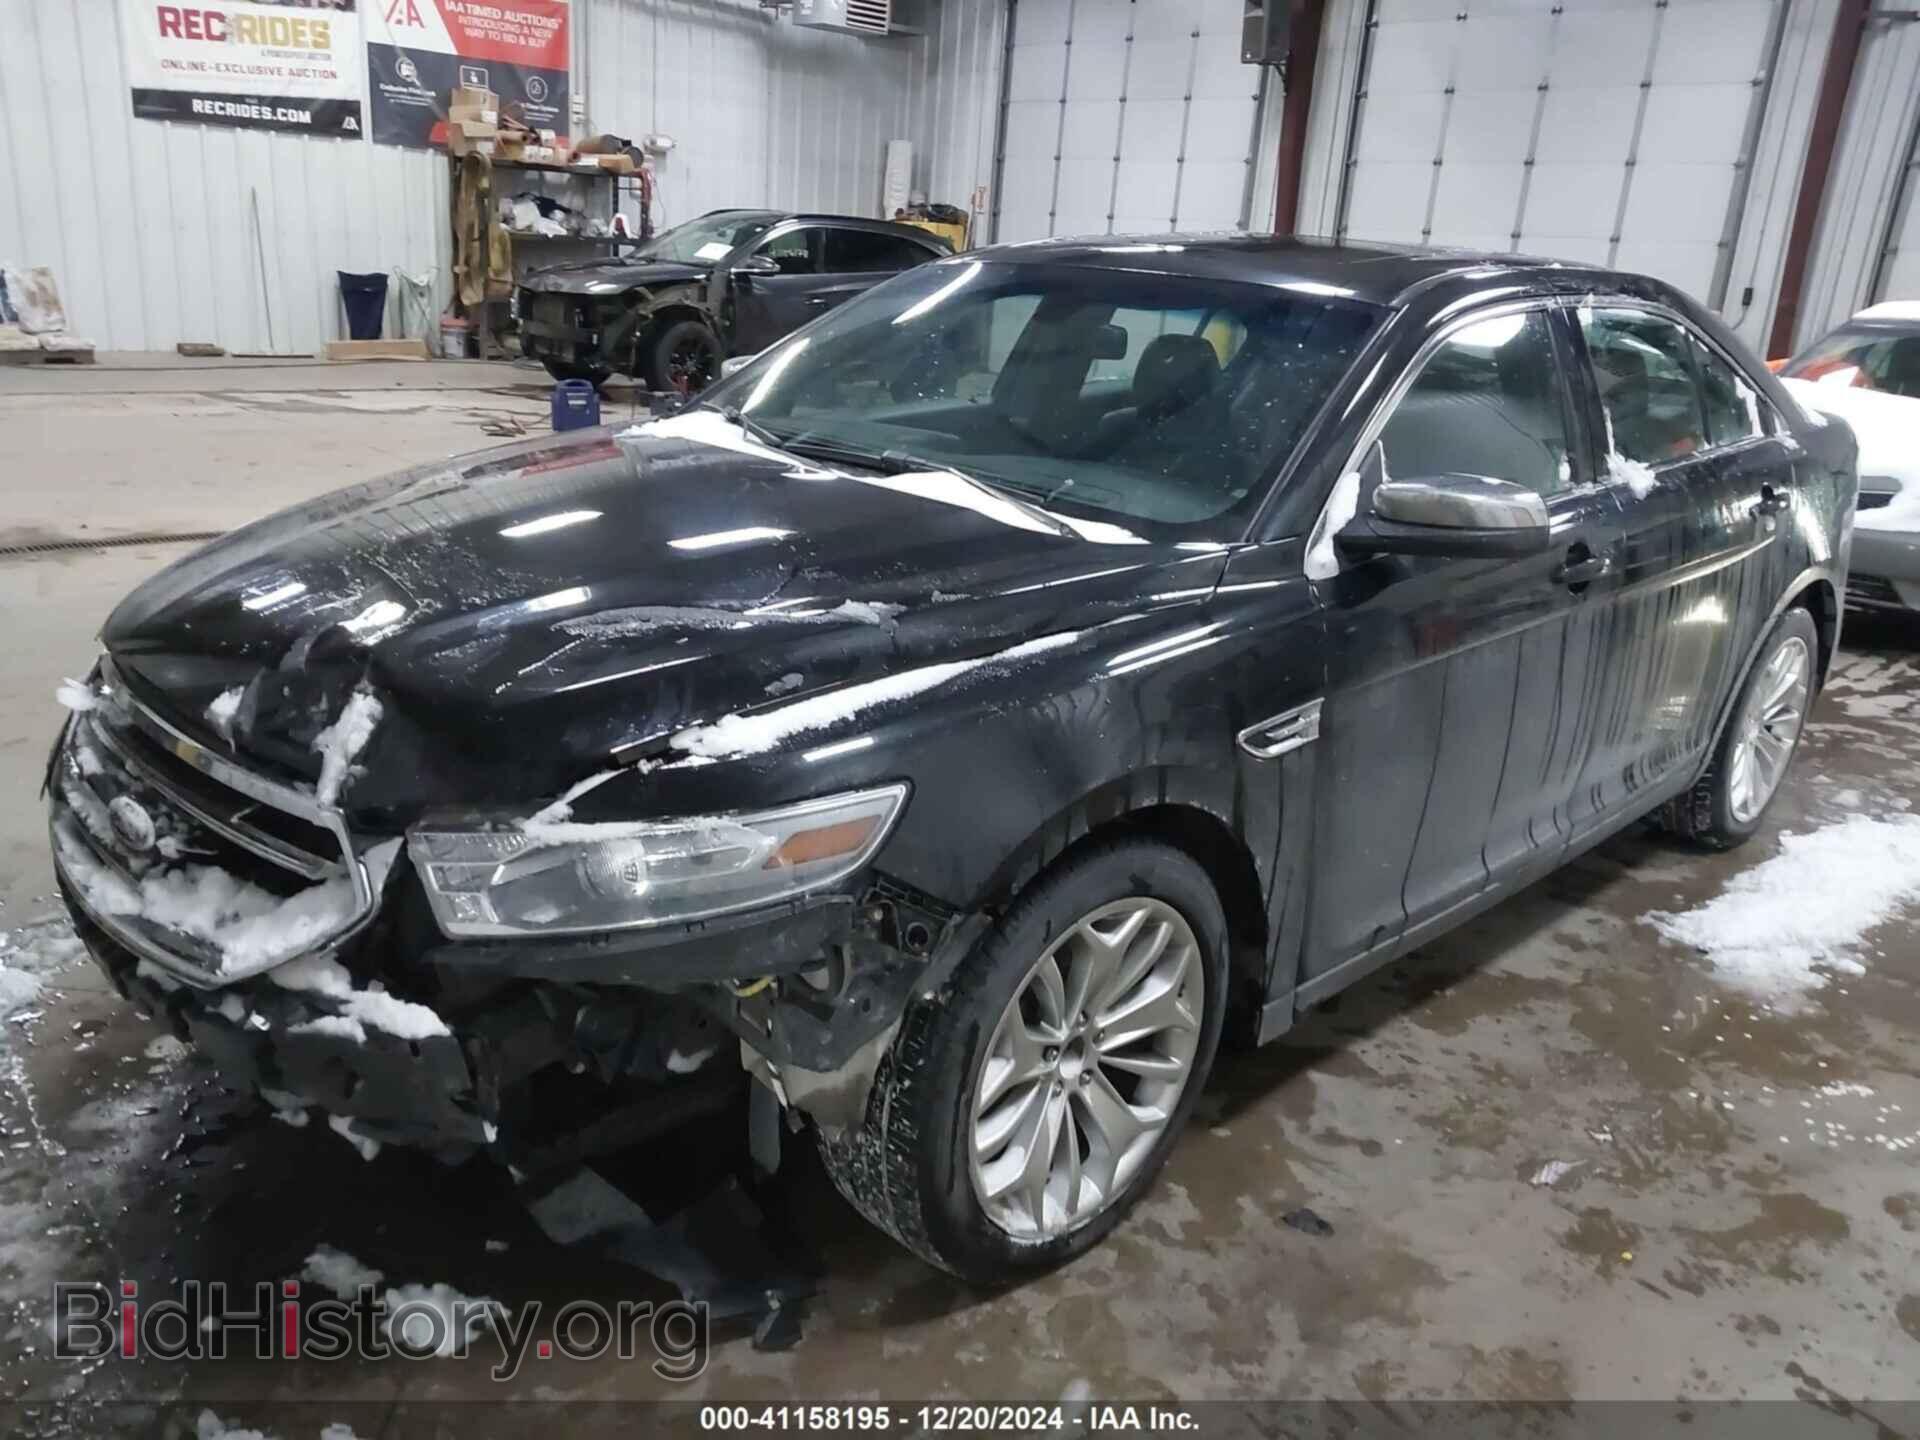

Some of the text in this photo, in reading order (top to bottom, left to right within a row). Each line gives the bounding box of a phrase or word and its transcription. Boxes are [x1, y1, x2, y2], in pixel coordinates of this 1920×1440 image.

[444, 0, 464, 13] IAA
[464, 3, 502, 20] TIMED
[157, 6, 332, 50] REC RIDES
[486, 30, 501, 41] TO
[160, 58, 338, 80] ONLINE-EXCLUSIVE AUCTION
[192, 98, 312, 124] RECRIDES.COM
